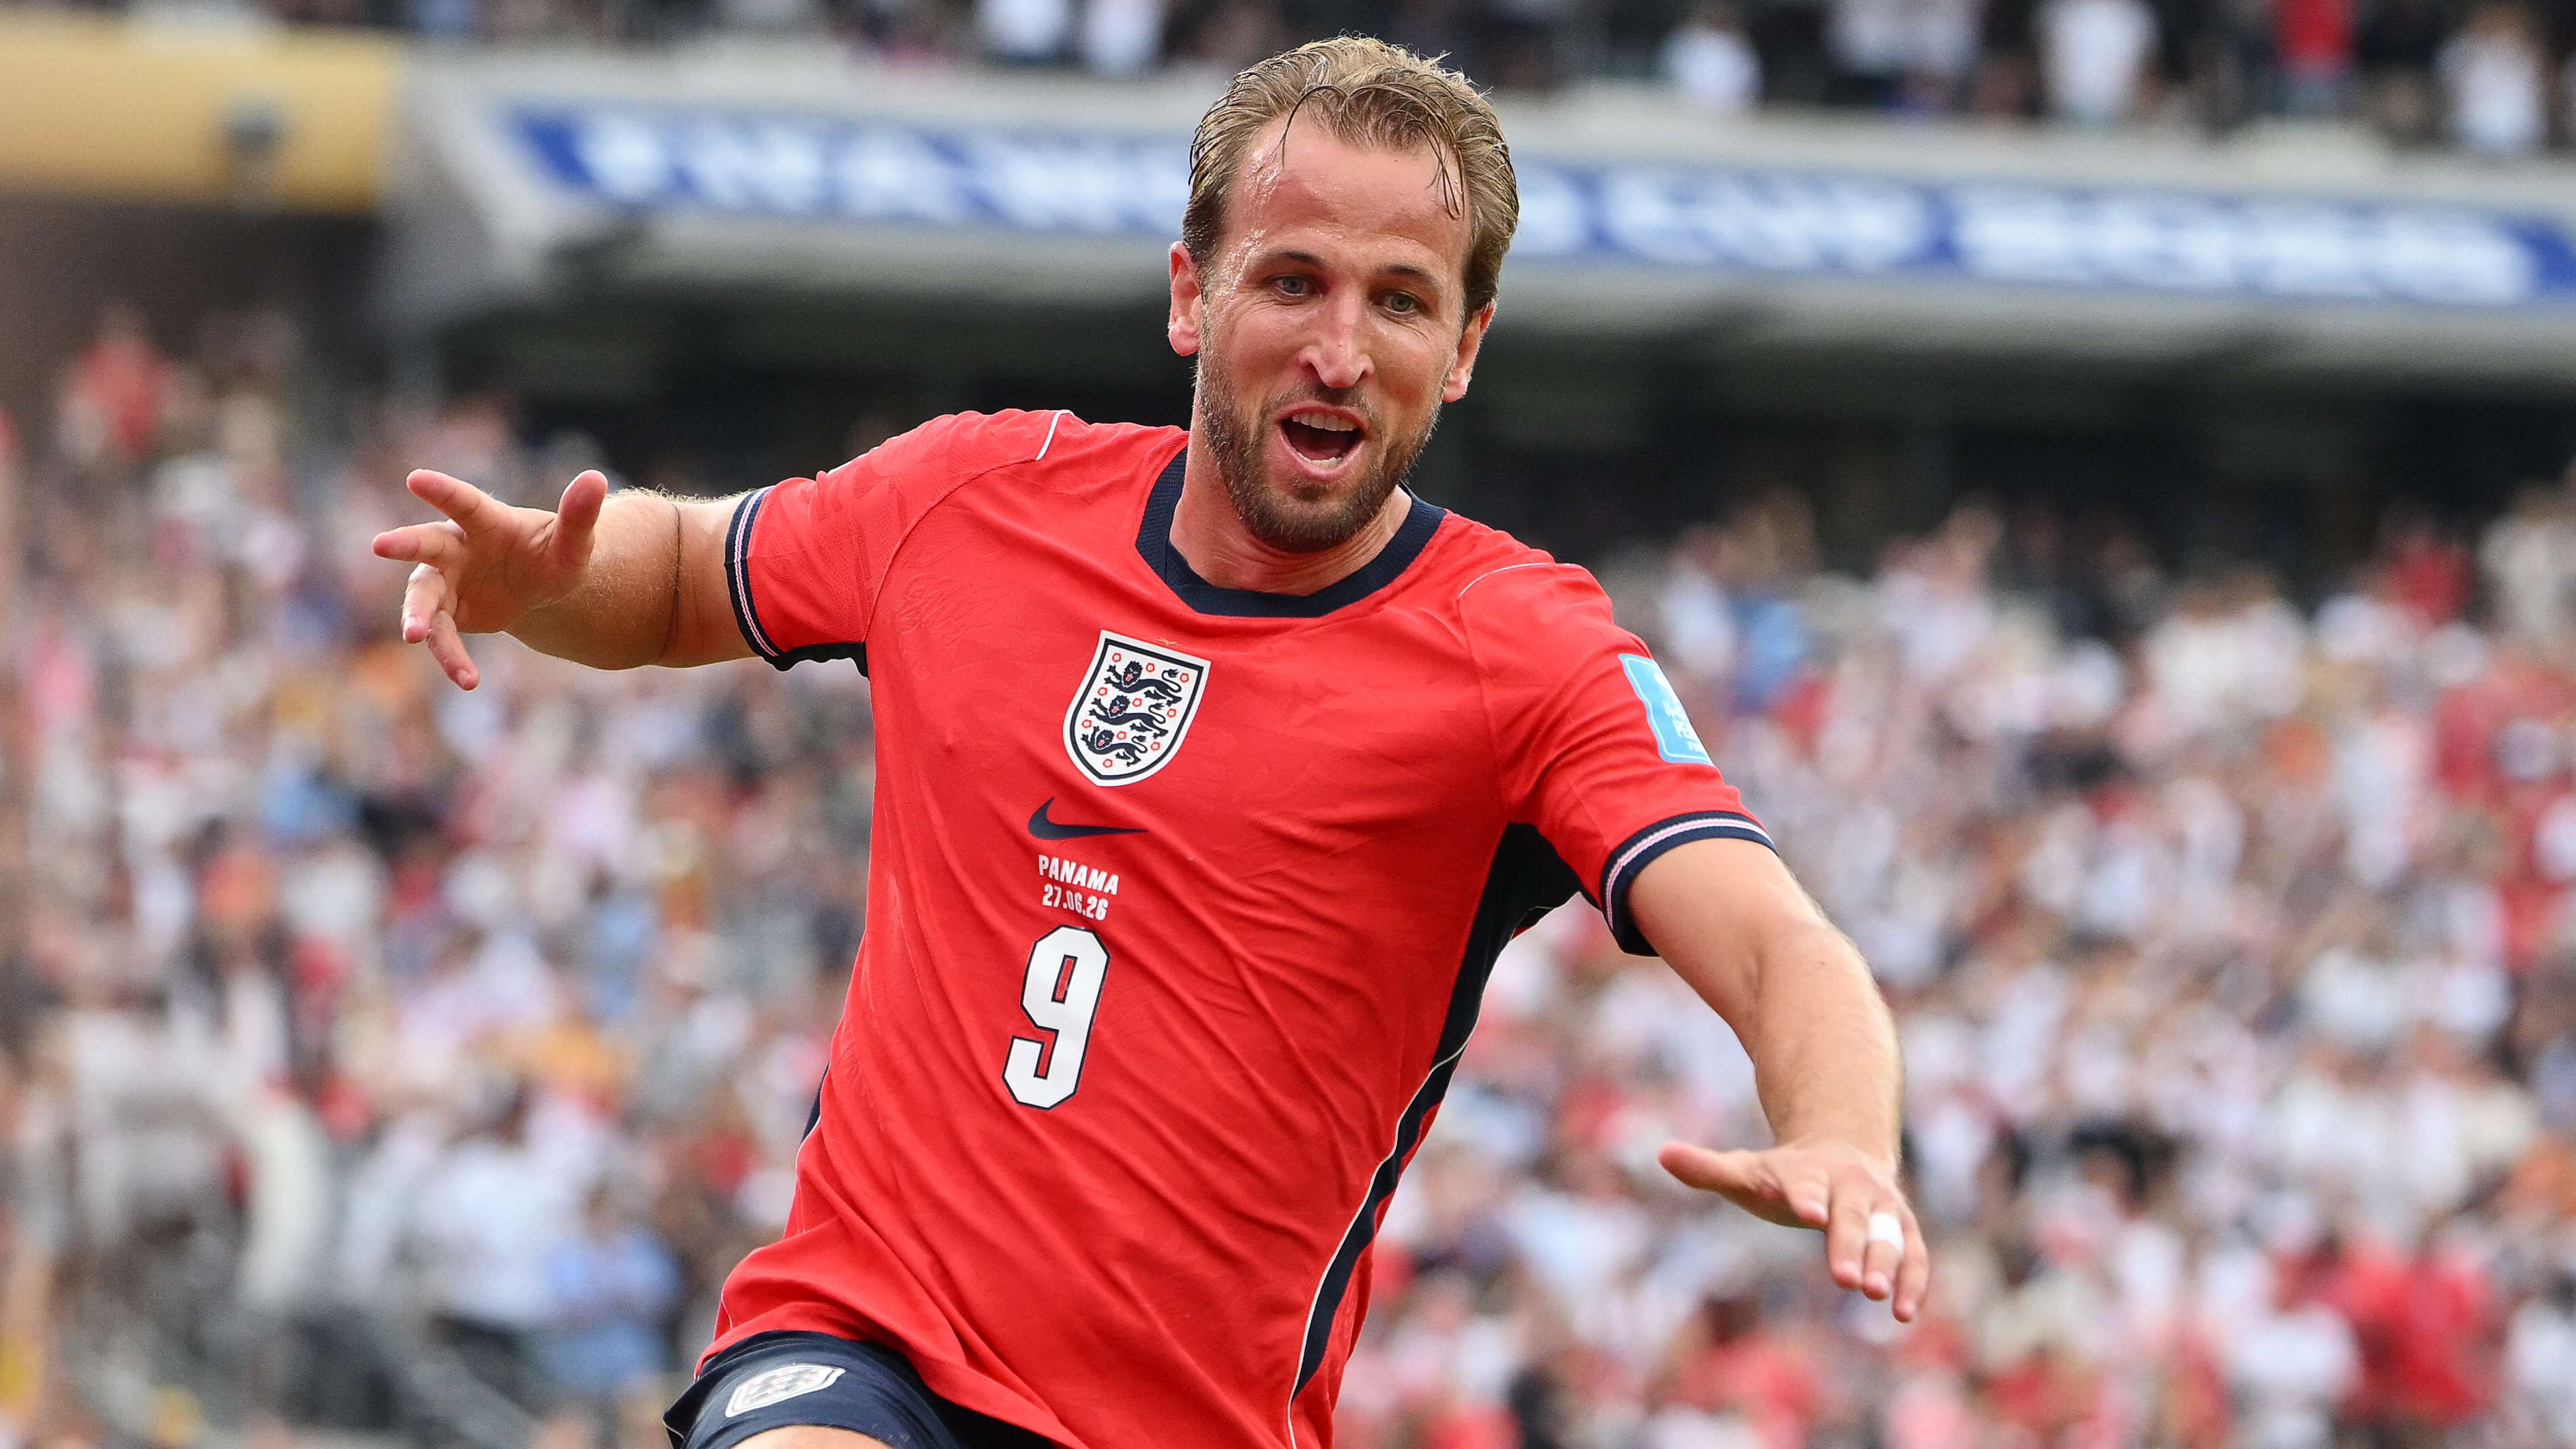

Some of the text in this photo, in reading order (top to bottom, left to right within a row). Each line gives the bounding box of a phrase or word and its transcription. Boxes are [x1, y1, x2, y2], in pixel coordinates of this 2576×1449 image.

[1038, 854, 1119, 895] PANAMA
[1042, 883, 1109, 921] 27.06.26
[1001, 924, 1111, 1111] 9
